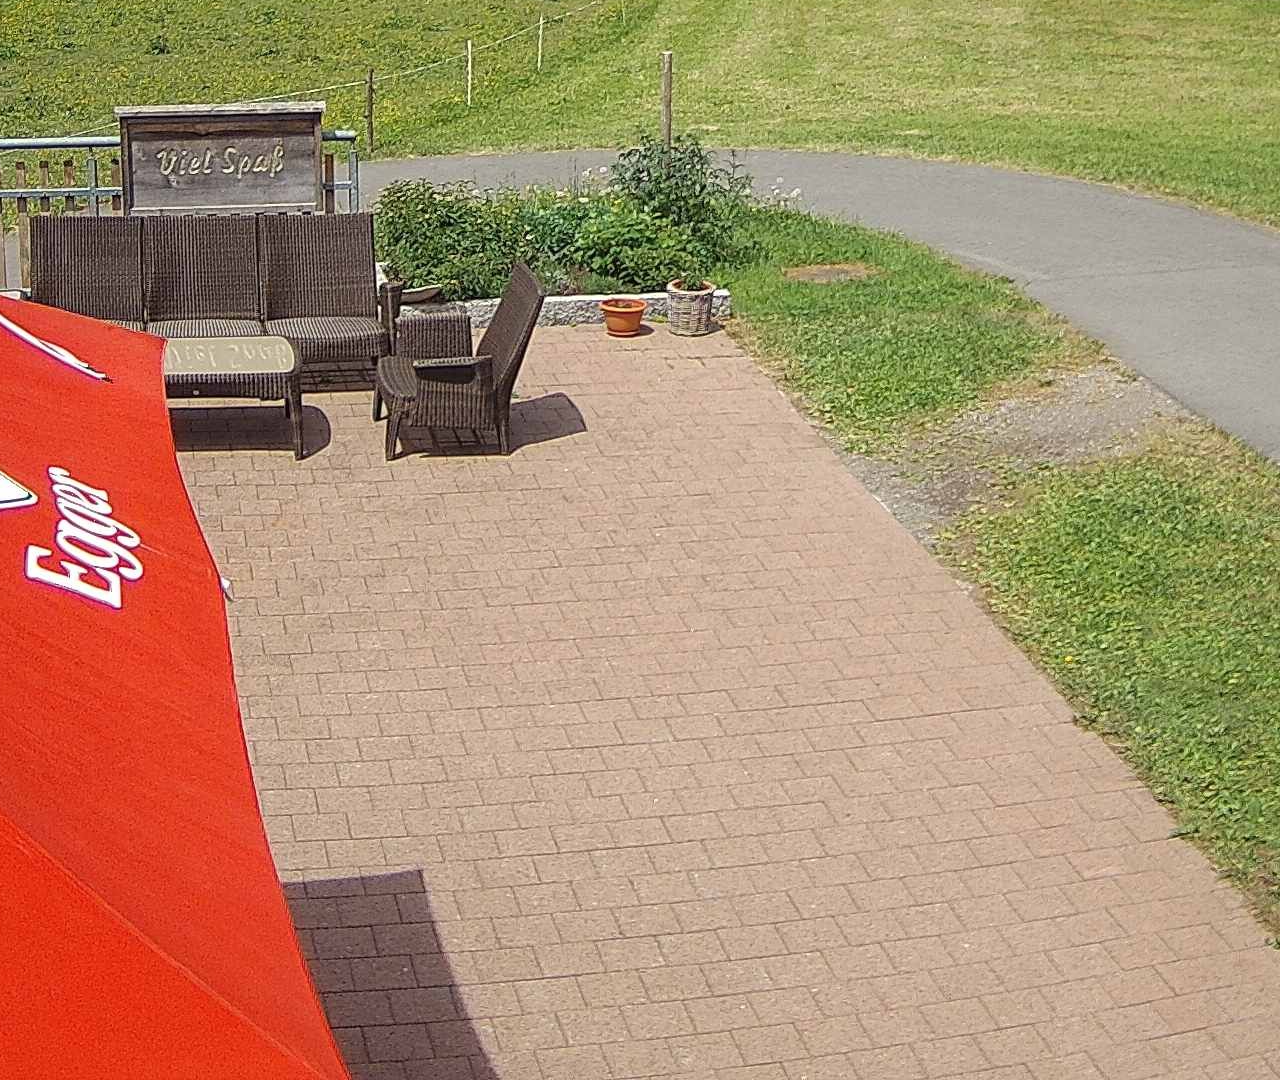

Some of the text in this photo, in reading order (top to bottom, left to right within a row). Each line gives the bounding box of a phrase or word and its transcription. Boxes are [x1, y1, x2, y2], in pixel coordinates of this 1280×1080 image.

[156, 142, 285, 179] Viel Spaß
[24, 465, 144, 609] Egger
